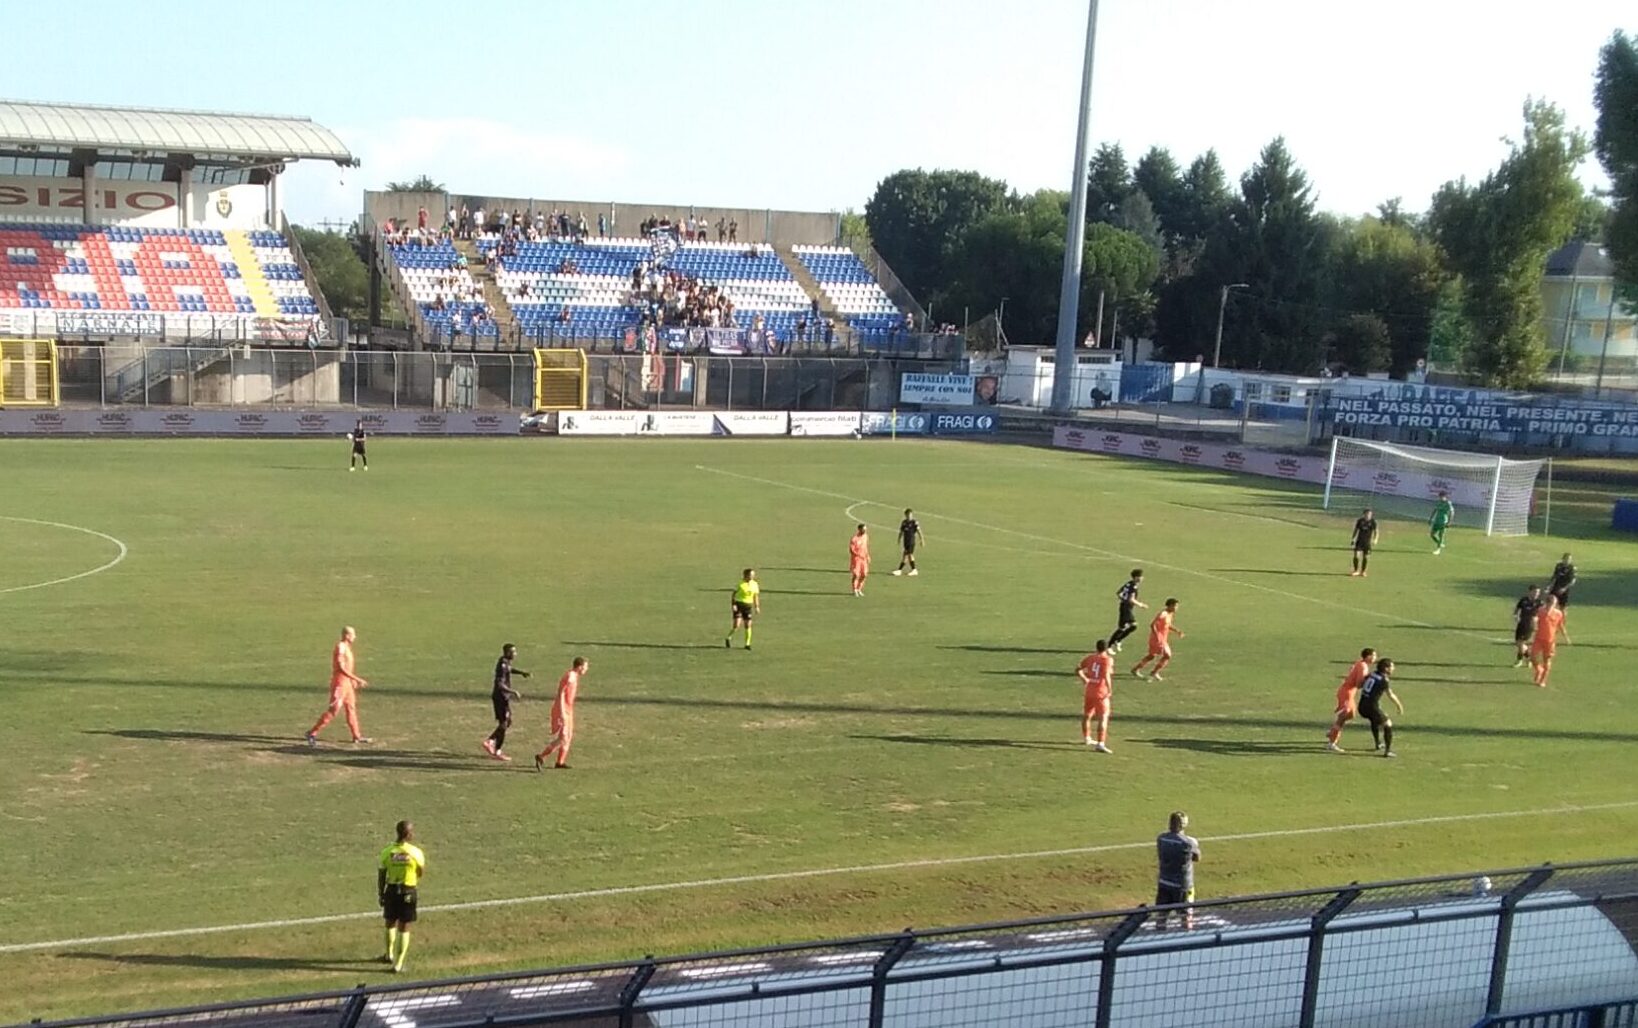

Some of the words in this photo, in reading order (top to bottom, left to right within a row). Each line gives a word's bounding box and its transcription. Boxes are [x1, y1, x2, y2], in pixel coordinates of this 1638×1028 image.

[948, 376, 966, 385] VIVE
[904, 384, 935, 393] SEMPRE
[1339, 400, 1372, 412] NEL
[1378, 401, 1460, 417] PASSATO,
[1466, 406, 1501, 417] NEL
[837, 414, 857, 422] filati
[869, 416, 905, 428] FRAGI
[937, 416, 974, 428] FRAGI
[1334, 412, 1392, 425] FORZA
[1397, 415, 1433, 427] PRO
[1438, 417, 1500, 431] PATRIA
[1528, 420, 1587, 434] PRIMO
[1091, 661, 1101, 678] 4
